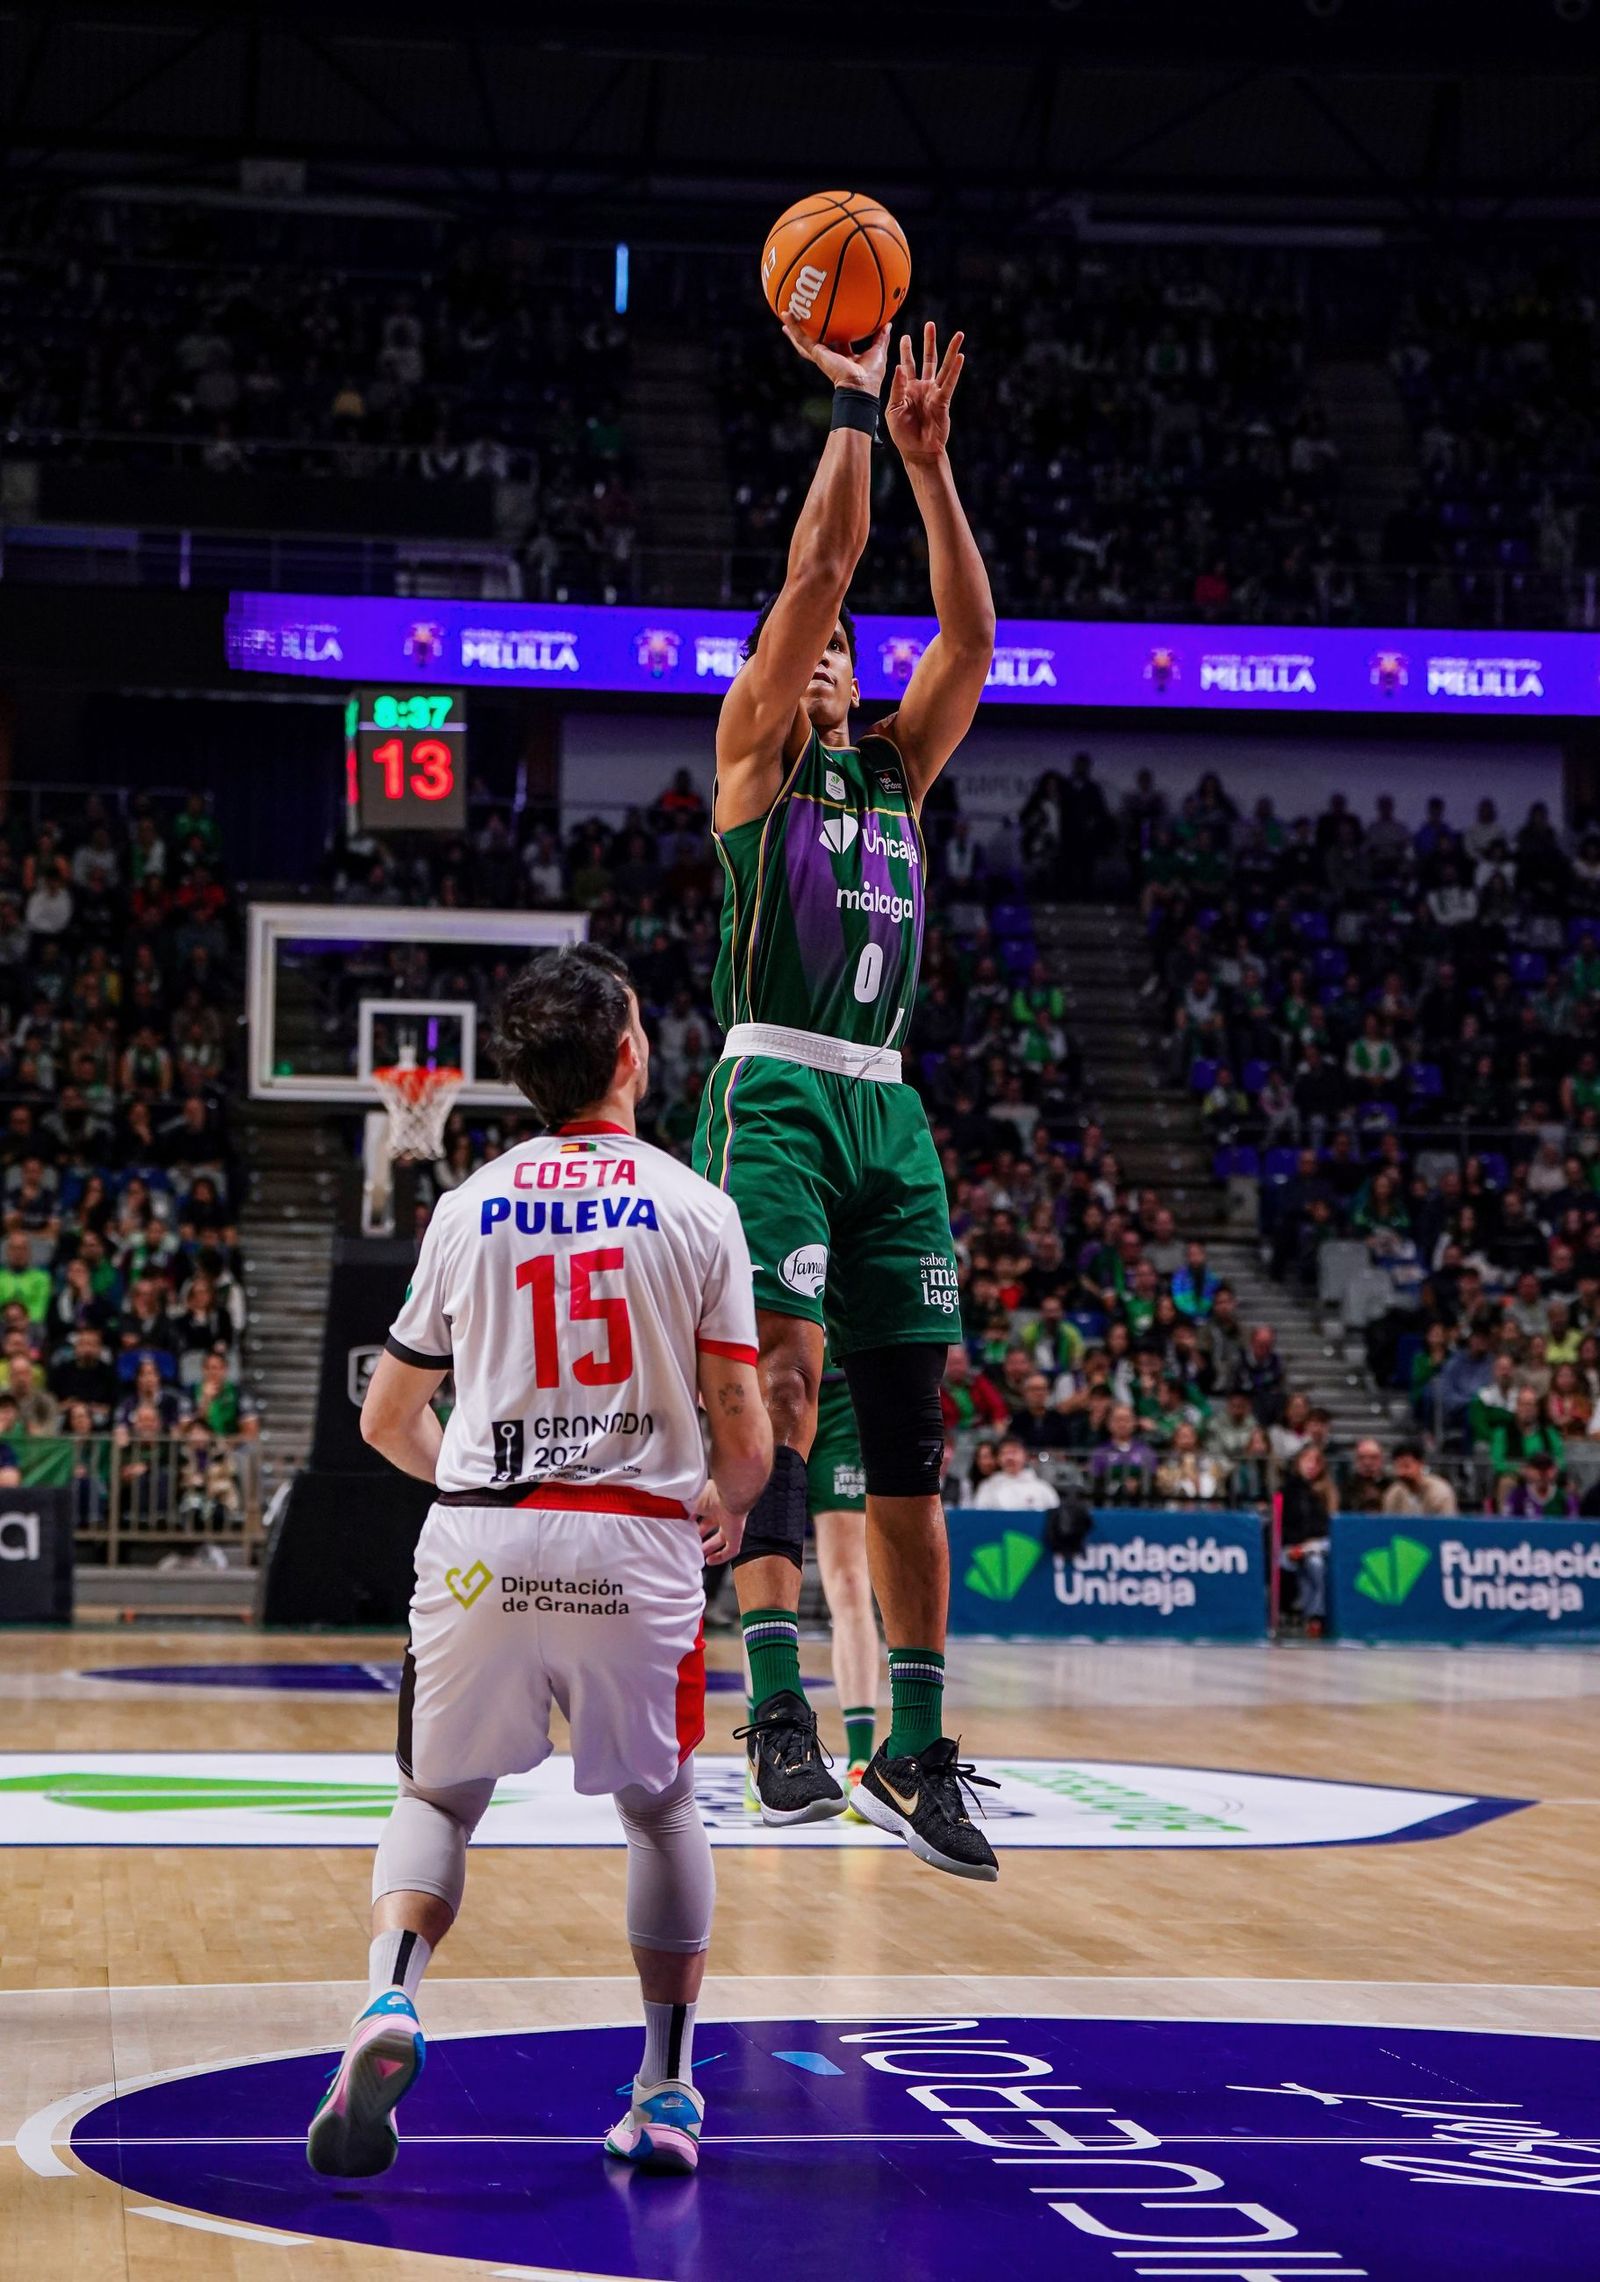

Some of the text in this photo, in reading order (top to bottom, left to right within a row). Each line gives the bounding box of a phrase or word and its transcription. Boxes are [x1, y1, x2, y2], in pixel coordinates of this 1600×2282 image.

[373, 695, 454, 729] 8:37
[372, 738, 454, 800] 13
[862, 827, 919, 868] Unicaja
[836, 880, 913, 923] málaga
[853, 942, 884, 1003] 0
[513, 1159, 637, 1190] COSTA
[480, 1196, 660, 1236] PULEVA
[919, 1252, 948, 1266] sabor
[922, 1281, 960, 1314] laga
[515, 1247, 634, 1389] 15
[501, 1576, 623, 1596] Diputación
[502, 1596, 630, 1615] de Granada
[1054, 1570, 1196, 1615] Unicaja
[1442, 1575, 1583, 1620] Unicaja
